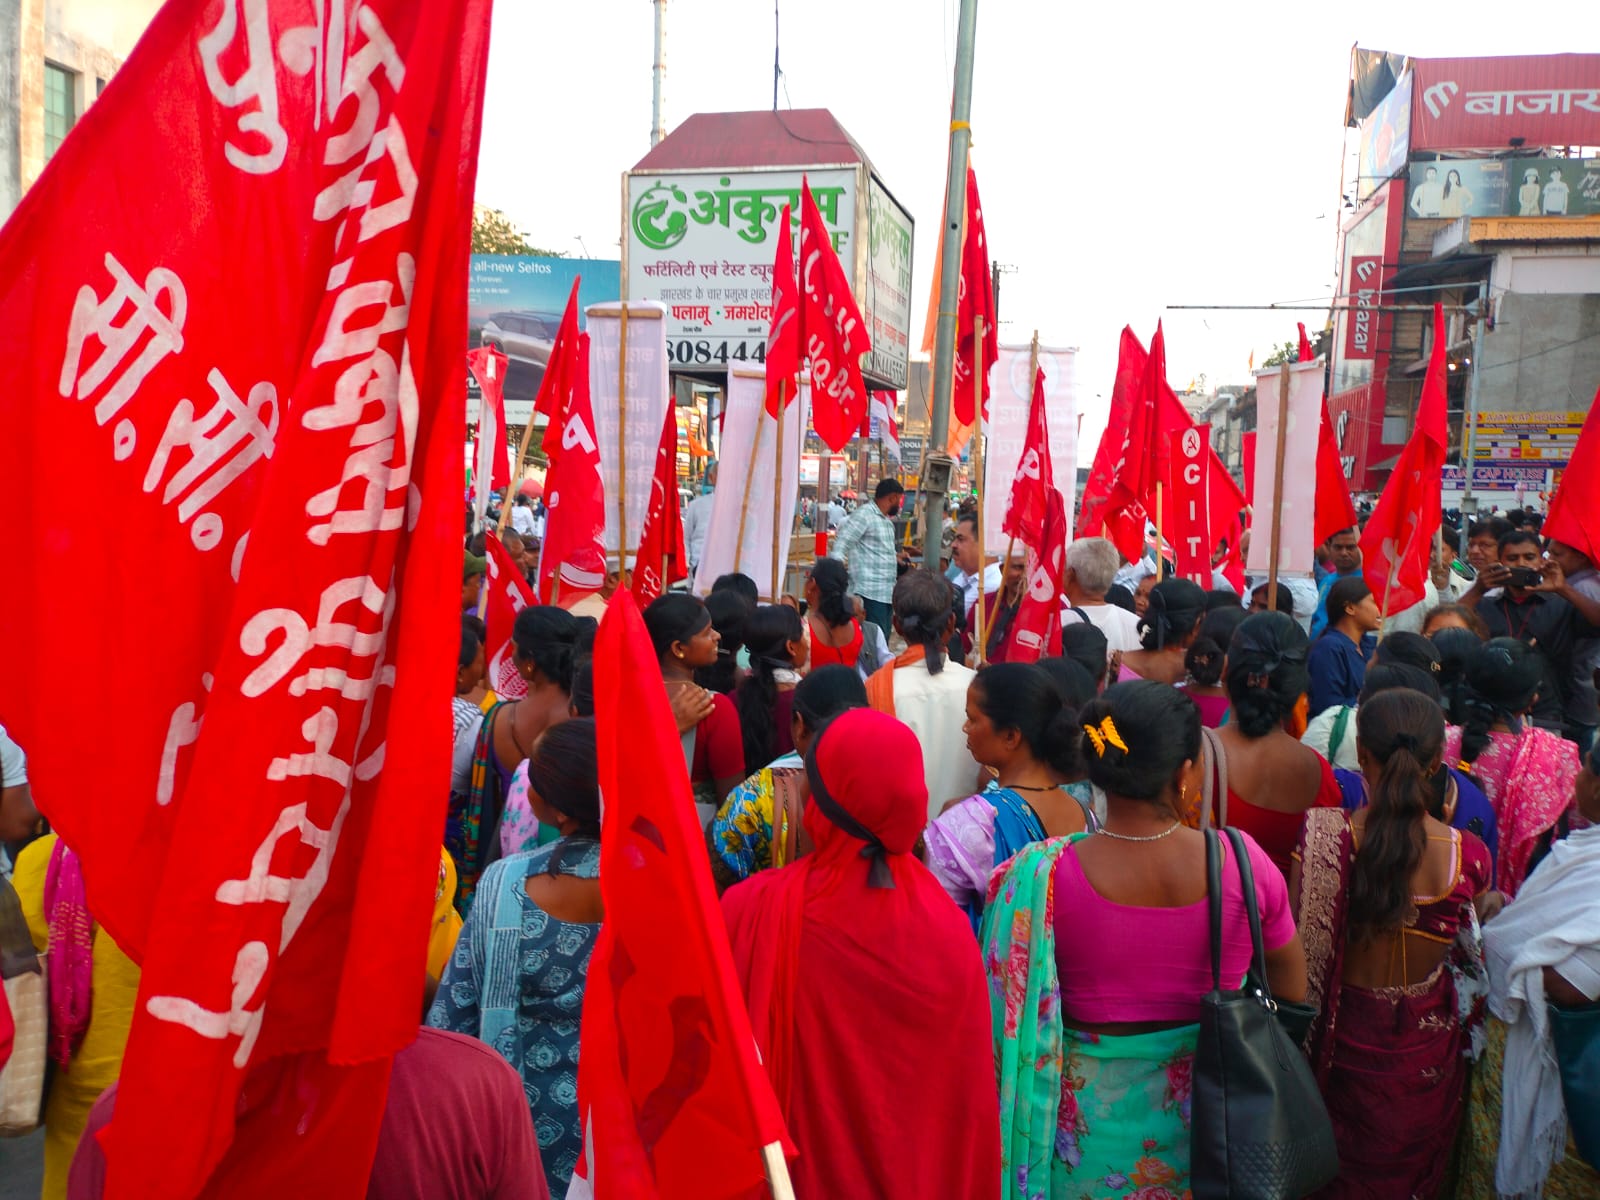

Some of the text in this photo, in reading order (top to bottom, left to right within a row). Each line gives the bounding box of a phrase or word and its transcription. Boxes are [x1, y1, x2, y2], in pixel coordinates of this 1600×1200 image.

[1464, 88, 1600, 116] बाजार
[474, 260, 552, 274] all-new Seltos
[643, 260, 697, 278] फर्टिलिटी
[700, 261, 719, 279] एवं
[722, 260, 747, 277] टेस्ट
[671, 305, 713, 326] पलामू
[1476, 468, 1502, 480] CAP
